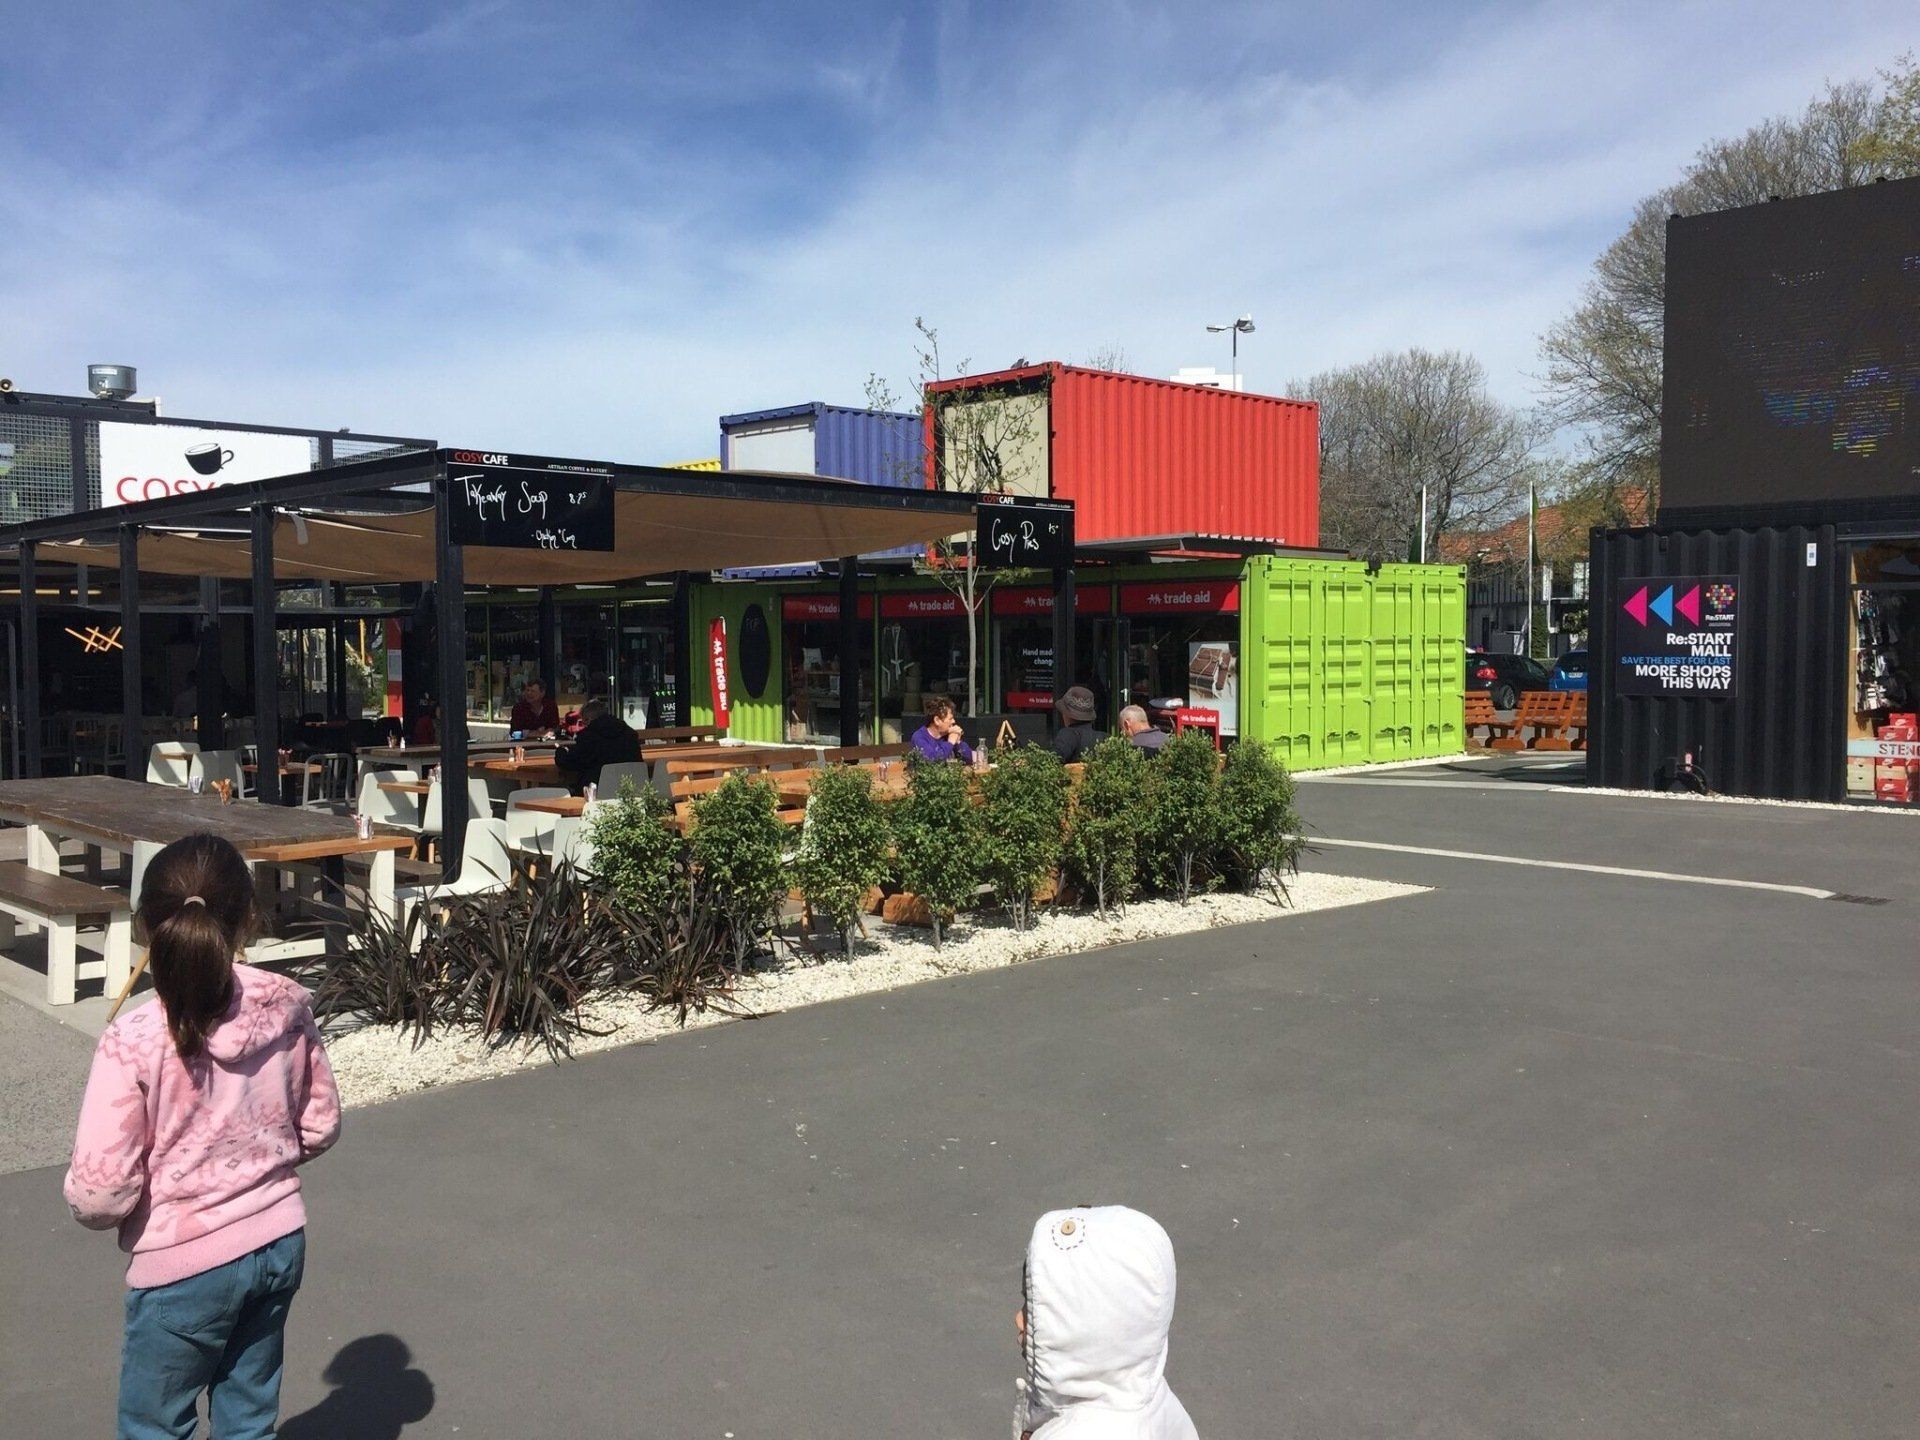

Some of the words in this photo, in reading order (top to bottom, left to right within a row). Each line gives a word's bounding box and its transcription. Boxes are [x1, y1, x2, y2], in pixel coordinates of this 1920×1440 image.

[454, 451, 509, 465] COSYCAFE
[518, 481, 549, 520] Soup
[982, 494, 1015, 505] COSYCAFE
[991, 518, 1017, 564] Cosy
[1163, 591, 1193, 604] trade
[1193, 590, 1211, 603] aid
[818, 604, 838, 614] trade
[920, 601, 942, 611] trade
[942, 600, 956, 611] aid
[1666, 633, 1734, 645] Re:START
[1022, 648, 1038, 656] Hand
[1039, 648, 1054, 656] mad
[1690, 645, 1732, 657] MALL
[1033, 657, 1054, 667] chang
[1621, 656, 1645, 664] SAVE
[1645, 656, 1664, 664] THE
[1664, 656, 1687, 665] BEST
[1688, 657, 1707, 665] FOR
[1707, 657, 1732, 665] LAST
[1635, 664, 1677, 676] MORE
[1680, 665, 1731, 677] SHOPS
[1660, 677, 1694, 688] THIS
[1696, 677, 1731, 690] WAY
